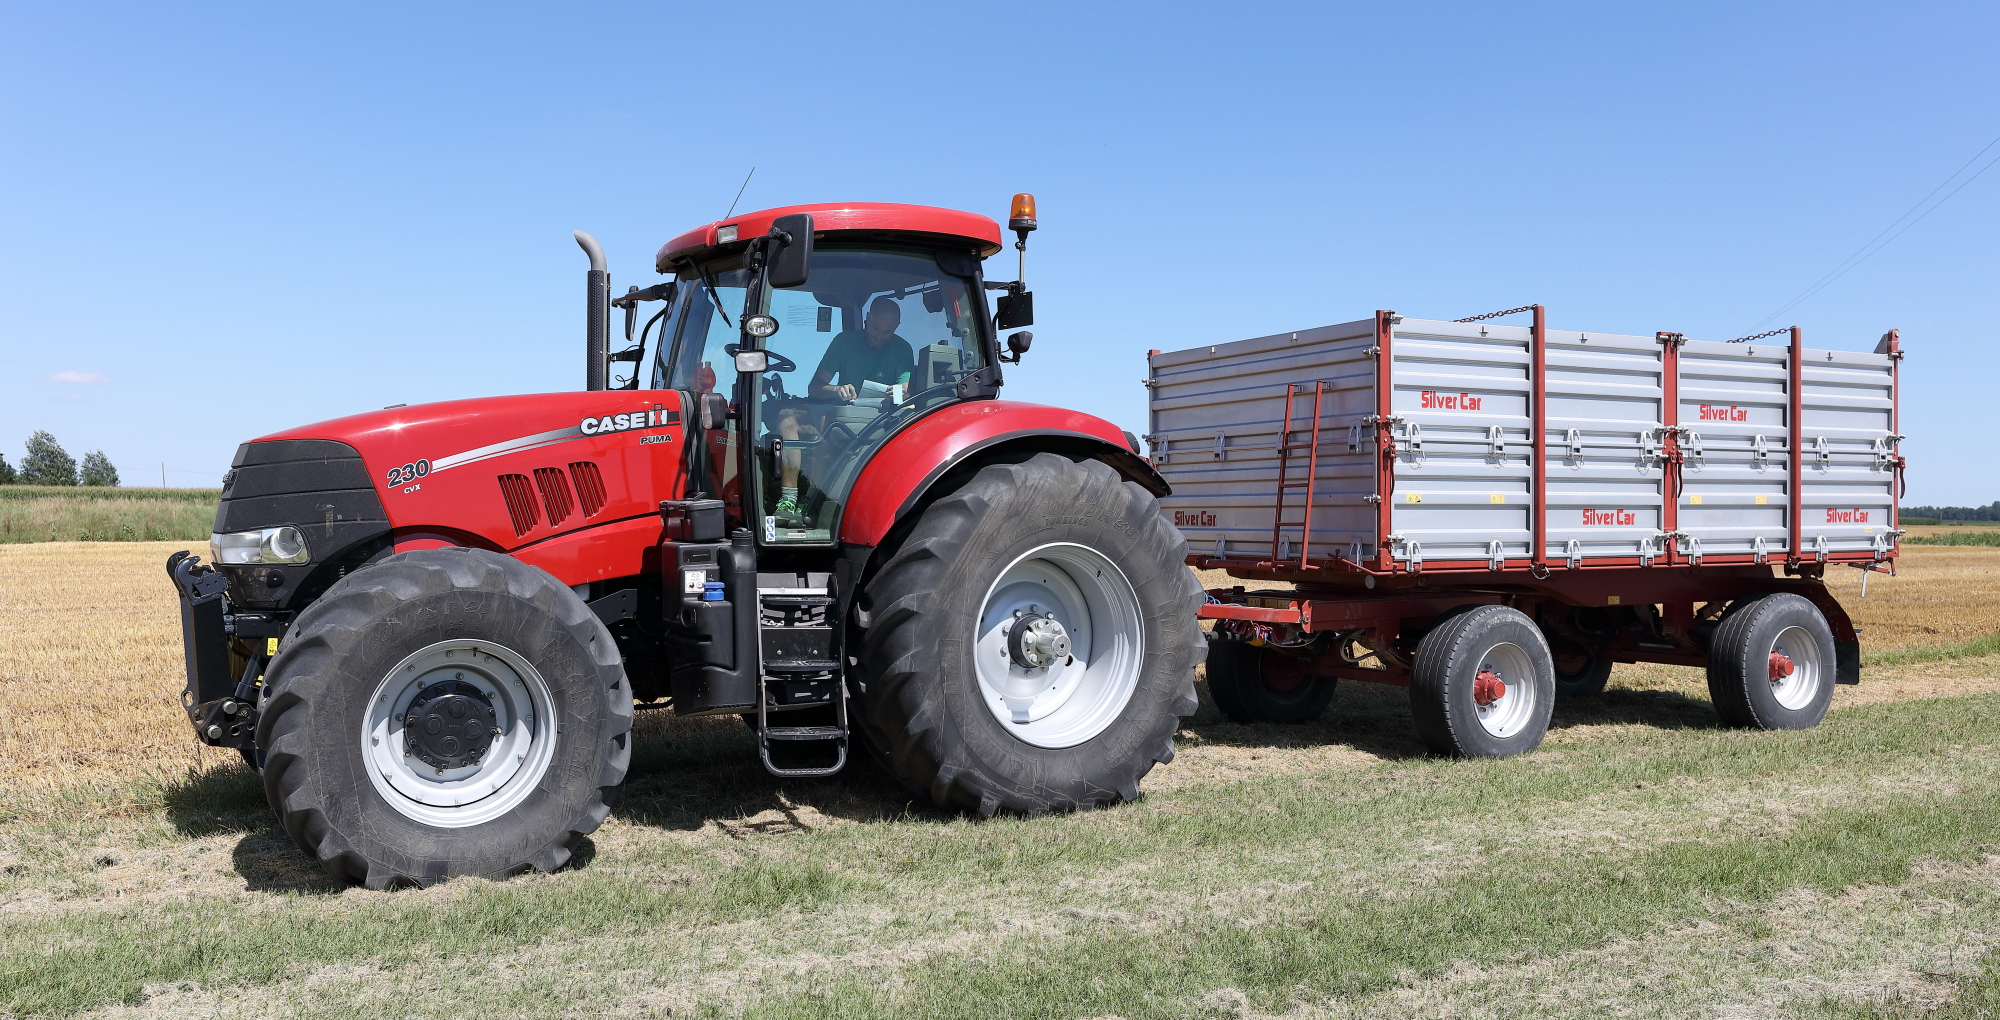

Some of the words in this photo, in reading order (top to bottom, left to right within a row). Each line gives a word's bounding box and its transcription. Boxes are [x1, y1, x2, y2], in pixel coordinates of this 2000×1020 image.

[1421, 390, 1457, 409] Silver
[1460, 392, 1481, 410] Car
[1699, 404, 1728, 421] Silver
[1730, 405, 1748, 421] Car
[580, 412, 646, 436] CASE
[640, 434, 672, 445] PUMA
[386, 458, 430, 489] 230
[403, 483, 421, 494] CVX
[1174, 510, 1200, 526] Silver
[1200, 510, 1217, 527] Car
[1582, 508, 1614, 526] Silver
[1616, 508, 1636, 526] Car
[1826, 507, 1852, 523] Silver
[1853, 507, 1869, 523] Car
